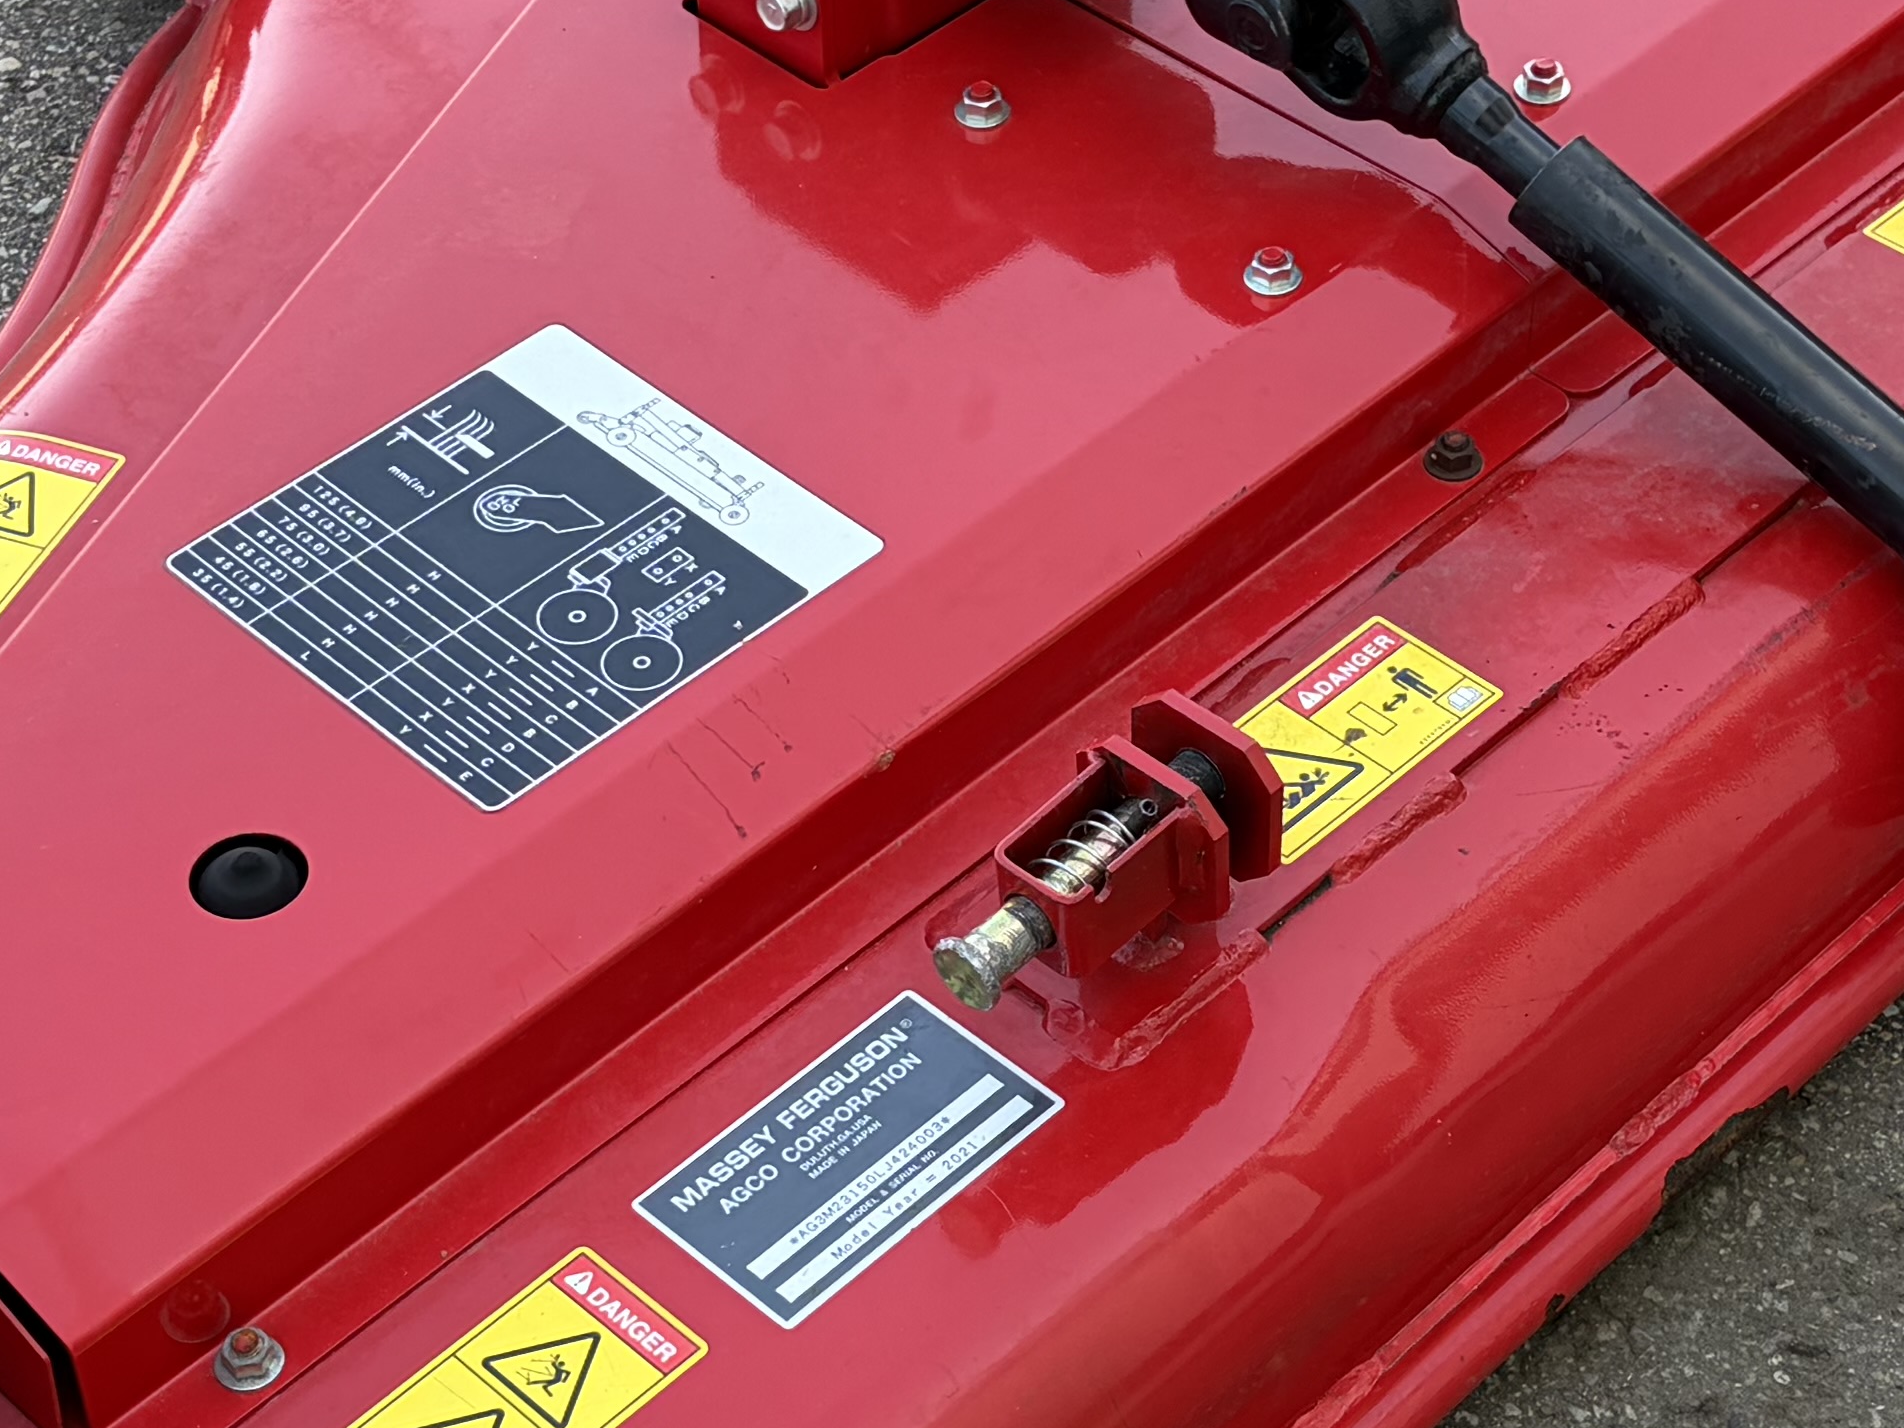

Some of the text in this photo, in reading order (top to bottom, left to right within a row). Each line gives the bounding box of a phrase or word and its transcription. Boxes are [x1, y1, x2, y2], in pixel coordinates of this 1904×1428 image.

[11, 440, 101, 478] DANGER
[385, 597, 399, 607] H
[406, 584, 420, 594] H
[427, 570, 441, 580] H
[321, 638, 335, 648] H
[342, 624, 357, 634] H
[364, 610, 378, 621] H
[300, 650, 310, 661] L
[506, 655, 518, 664] Y
[566, 700, 578, 710] B
[527, 641, 539, 651] Y
[586, 687, 598, 696] A
[1318, 634, 1396, 696] DANGER
[462, 683, 476, 694] X
[523, 728, 536, 738] B
[485, 669, 497, 678] Y
[545, 714, 558, 724] C
[419, 711, 433, 722] X
[480, 757, 494, 767] C
[442, 697, 454, 706] Y
[501, 742, 515, 752] D
[400, 724, 412, 734] Y
[459, 771, 473, 782] E
[720, 1052, 922, 1215] AGCO CORPORATION
[808, 1120, 882, 1179] MADE IN JAPAN
[670, 1125, 776, 1212] MASSEY
[845, 1198, 880, 1223] MODEL
[888, 1164, 922, 1188] SERIAL
[830, 1222, 877, 1260] Model
[882, 1188, 917, 1216] Year
[942, 1141, 978, 1170] 2021
[586, 1284, 678, 1366] DANGER
